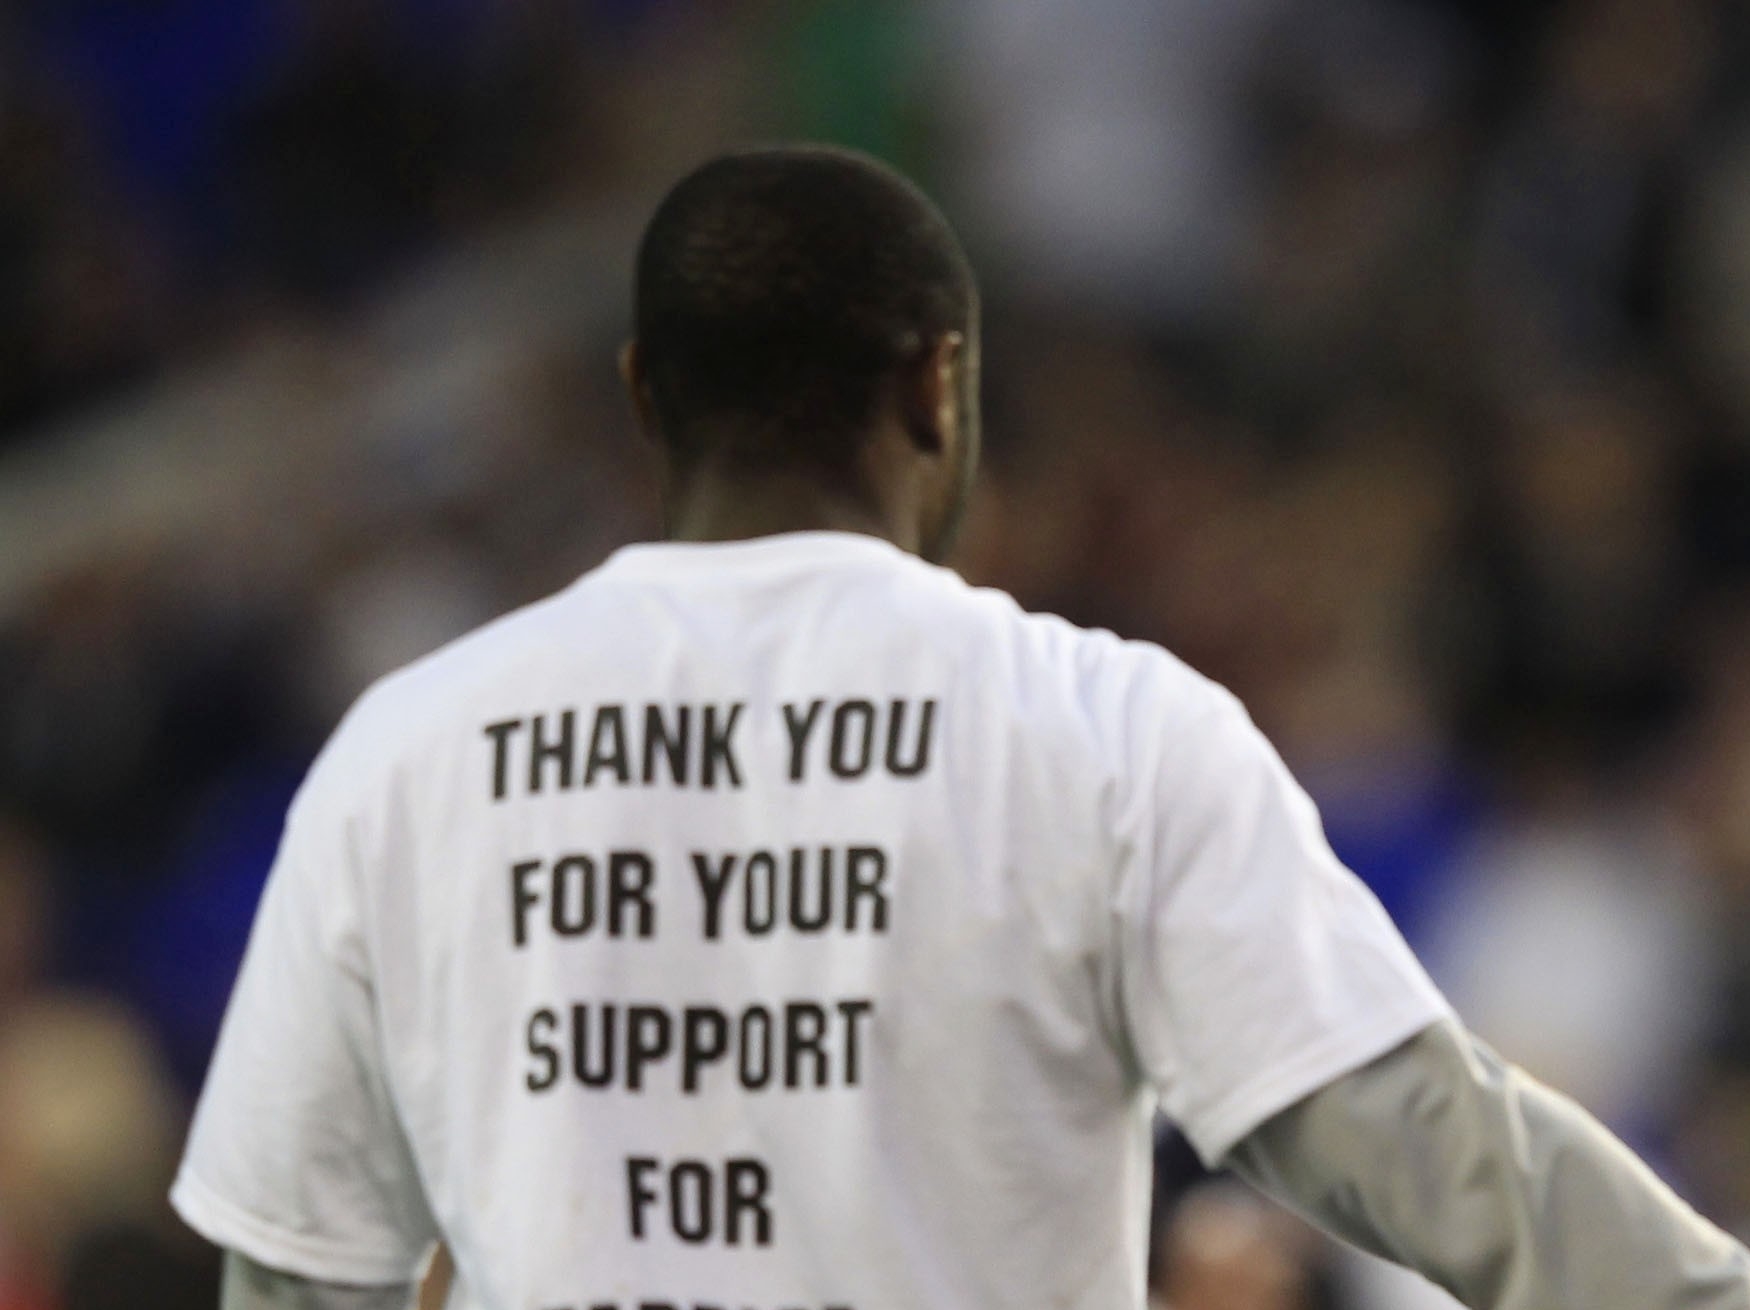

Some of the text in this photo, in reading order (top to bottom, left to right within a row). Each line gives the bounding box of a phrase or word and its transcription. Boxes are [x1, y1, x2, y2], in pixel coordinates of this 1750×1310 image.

[484, 698, 937, 803] THANK YOU
[511, 846, 889, 950] FOR YOUR
[525, 999, 874, 1094] SUPPORT
[626, 1156, 774, 1247] FOR
